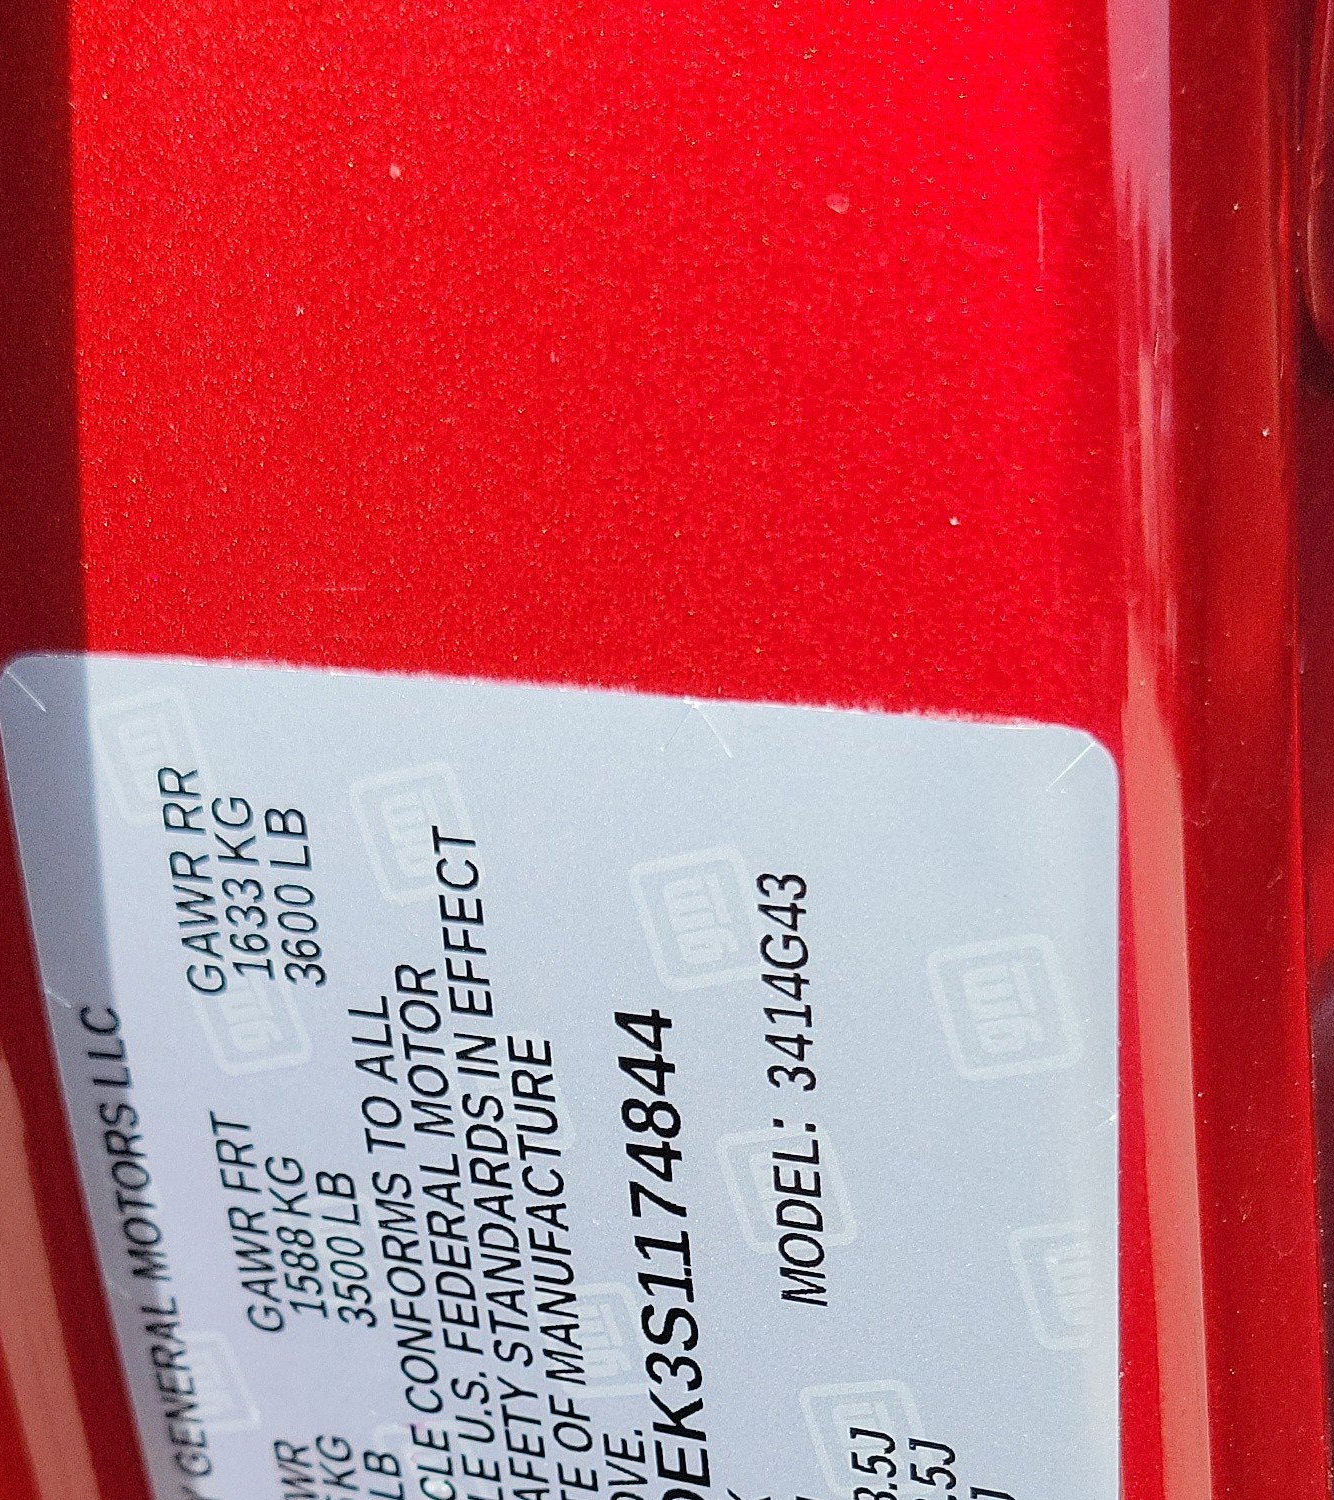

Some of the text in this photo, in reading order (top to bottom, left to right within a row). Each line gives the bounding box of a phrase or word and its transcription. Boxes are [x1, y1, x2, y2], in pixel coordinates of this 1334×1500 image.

[157, 767, 227, 994] GAWR RR
[211, 797, 275, 980] 1633 KG
[264, 808, 327, 988] 3600 LB
[431, 825, 493, 1018] EFFECT
[78, 1005, 132, 1089] LLC
[348, 996, 400, 1084] ALL
[361, 1096, 407, 1154] TO
[394, 963, 455, 1138] MOTOR
[453, 1032, 500, 1078] IN
[755, 873, 829, 1307] MODEL: 3414G43
[98, 1104, 171, 1282] MOTORS
[210, 1111, 285, 1333] GAWR FRT
[264, 1157, 328, 1318] 1588 KG
[315, 1171, 378, 1328] 3500 LB
[420, 1153, 484, 1356] FEDERAL
[461, 1093, 534, 1367] STANDARDS
[507, 1035, 586, 1386] MANUFACTURE
[372, 1172, 439, 1413] CONFORMS
[140, 1297, 213, 1477] GENERAL
[315, 1434, 358, 1491] KG
[363, 1451, 406, 1500] LB
[450, 1370, 495, 1444] U.S.
[549, 1394, 593, 1453] OF
